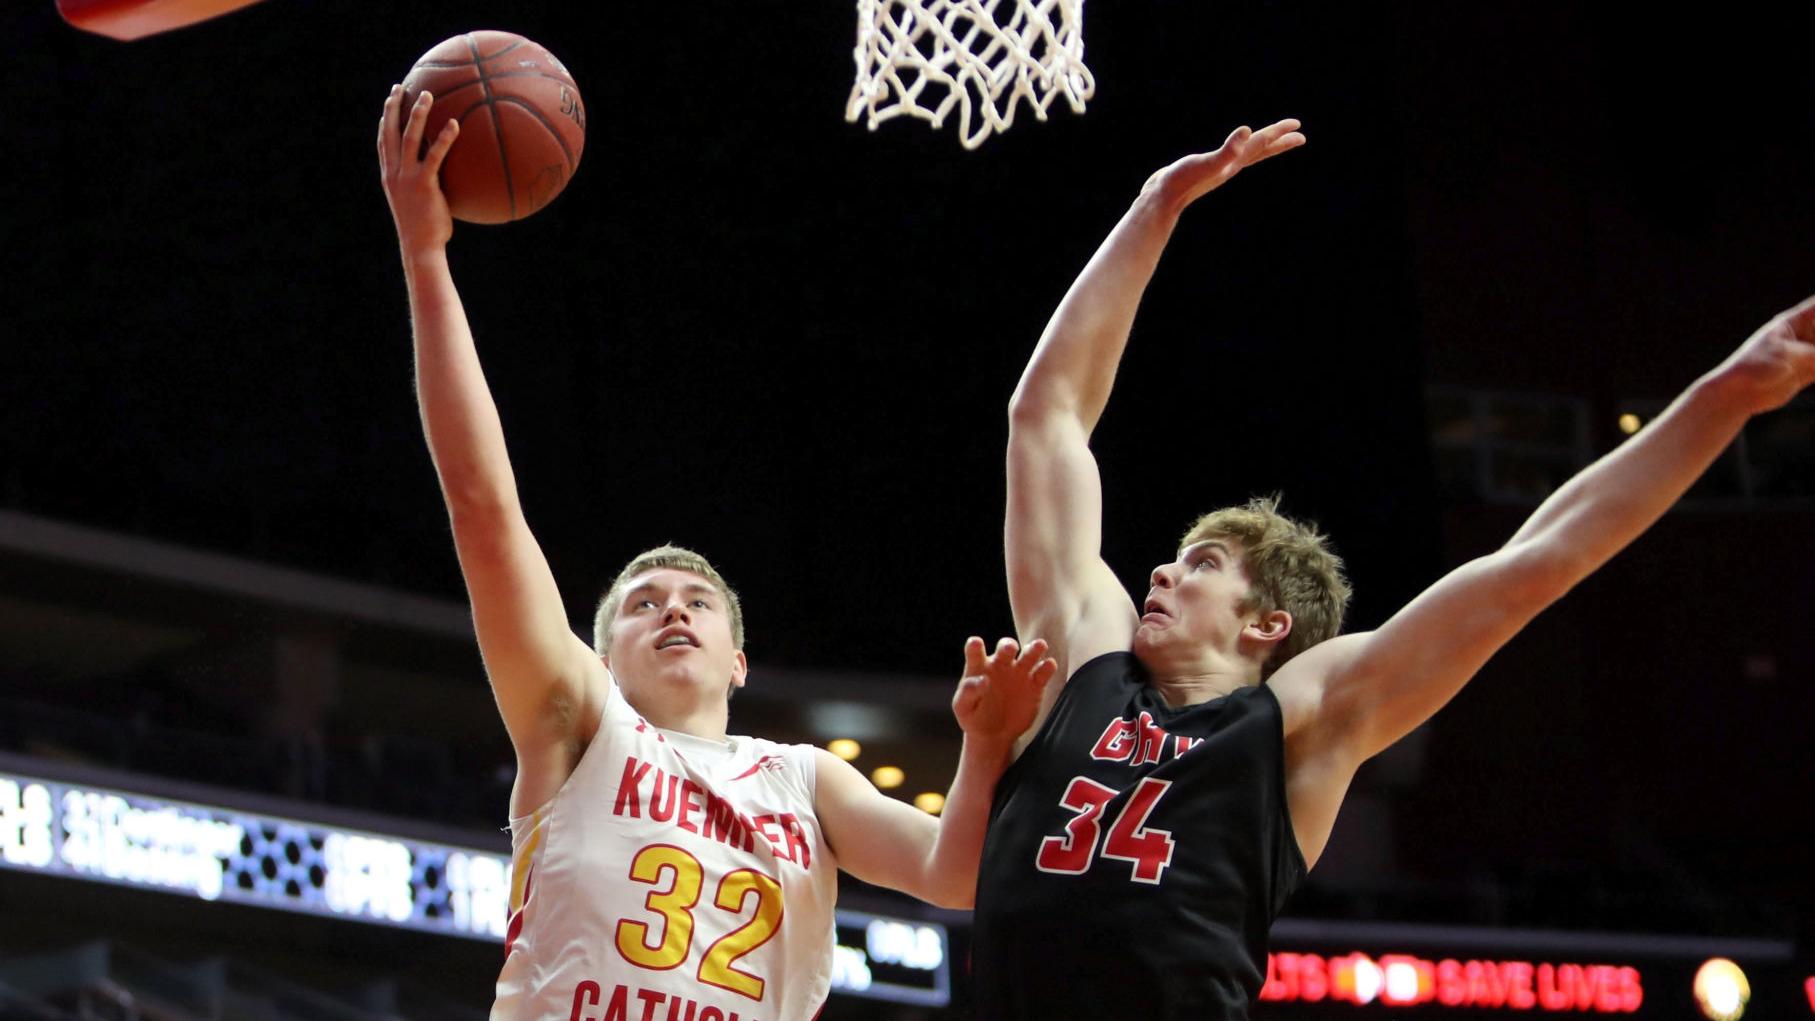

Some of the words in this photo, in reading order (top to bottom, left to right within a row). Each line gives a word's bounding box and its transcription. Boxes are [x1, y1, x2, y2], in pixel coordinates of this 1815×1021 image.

[1036, 776, 1176, 885] 34
[615, 843, 785, 1002] 32
[1260, 954, 1328, 1000] LTS
[1436, 959, 1536, 1008] SAVE
[1537, 963, 1643, 1012] LIVES
